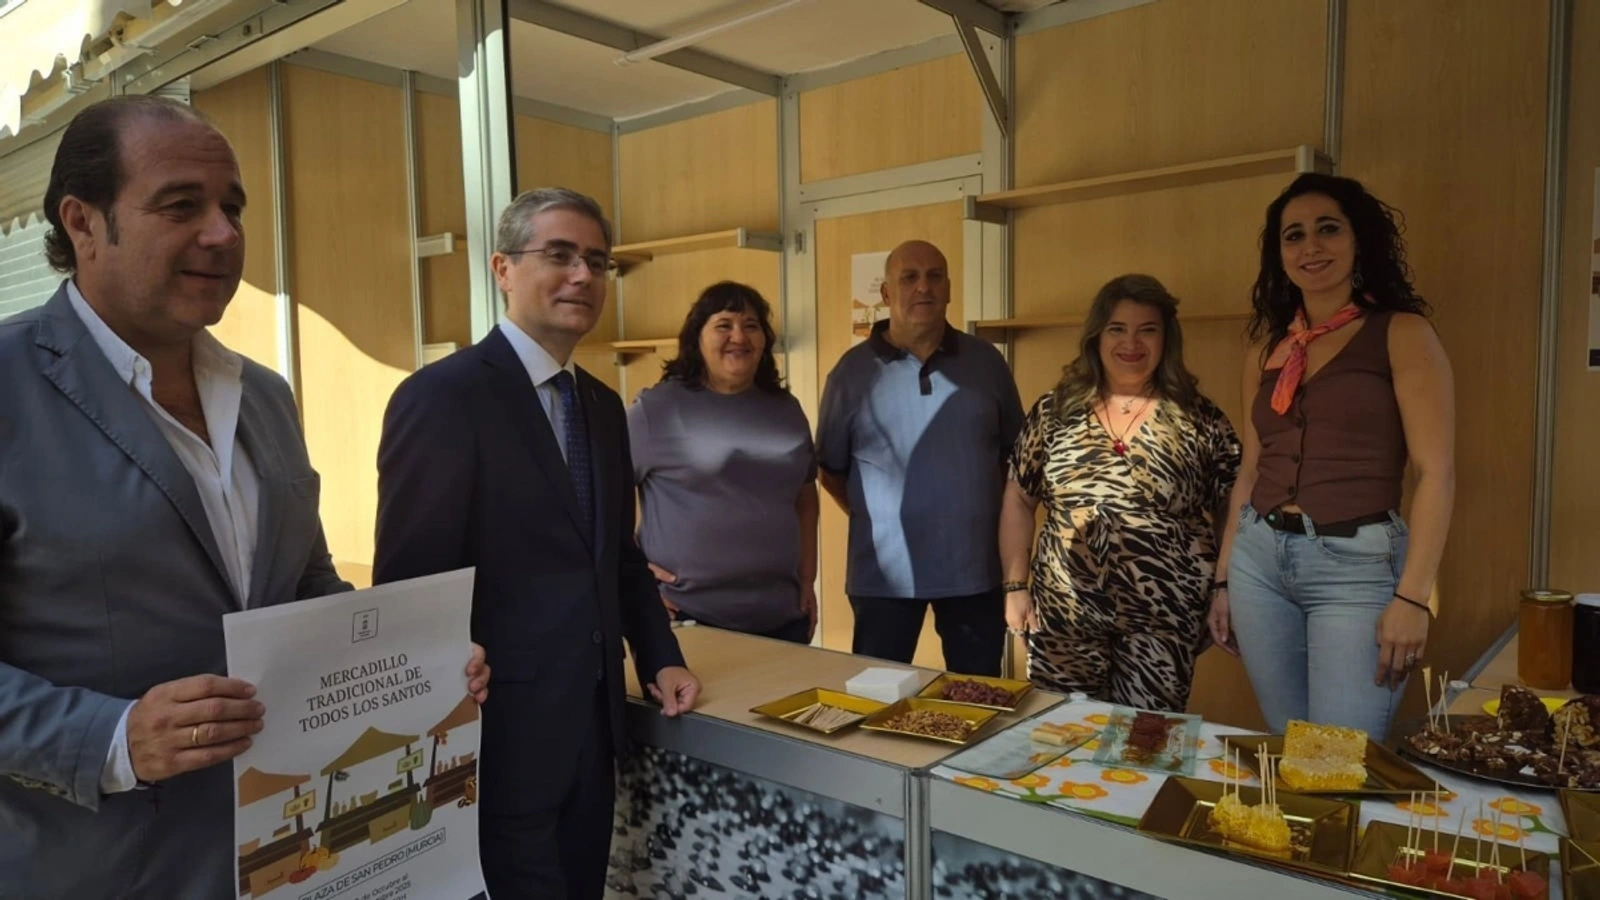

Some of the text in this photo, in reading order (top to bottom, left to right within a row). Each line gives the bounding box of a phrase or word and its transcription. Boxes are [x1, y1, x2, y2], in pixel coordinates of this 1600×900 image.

[306, 666, 423, 711] TRADICIONAL DE
[320, 653, 408, 689] MERCADILLO
[299, 680, 432, 733] TODOS LOS SANTOS
[335, 878, 350, 891] DE
[351, 868, 371, 884] SAN
[372, 852, 405, 873] PEDRO
[405, 832, 444, 858] (MURCIA)
